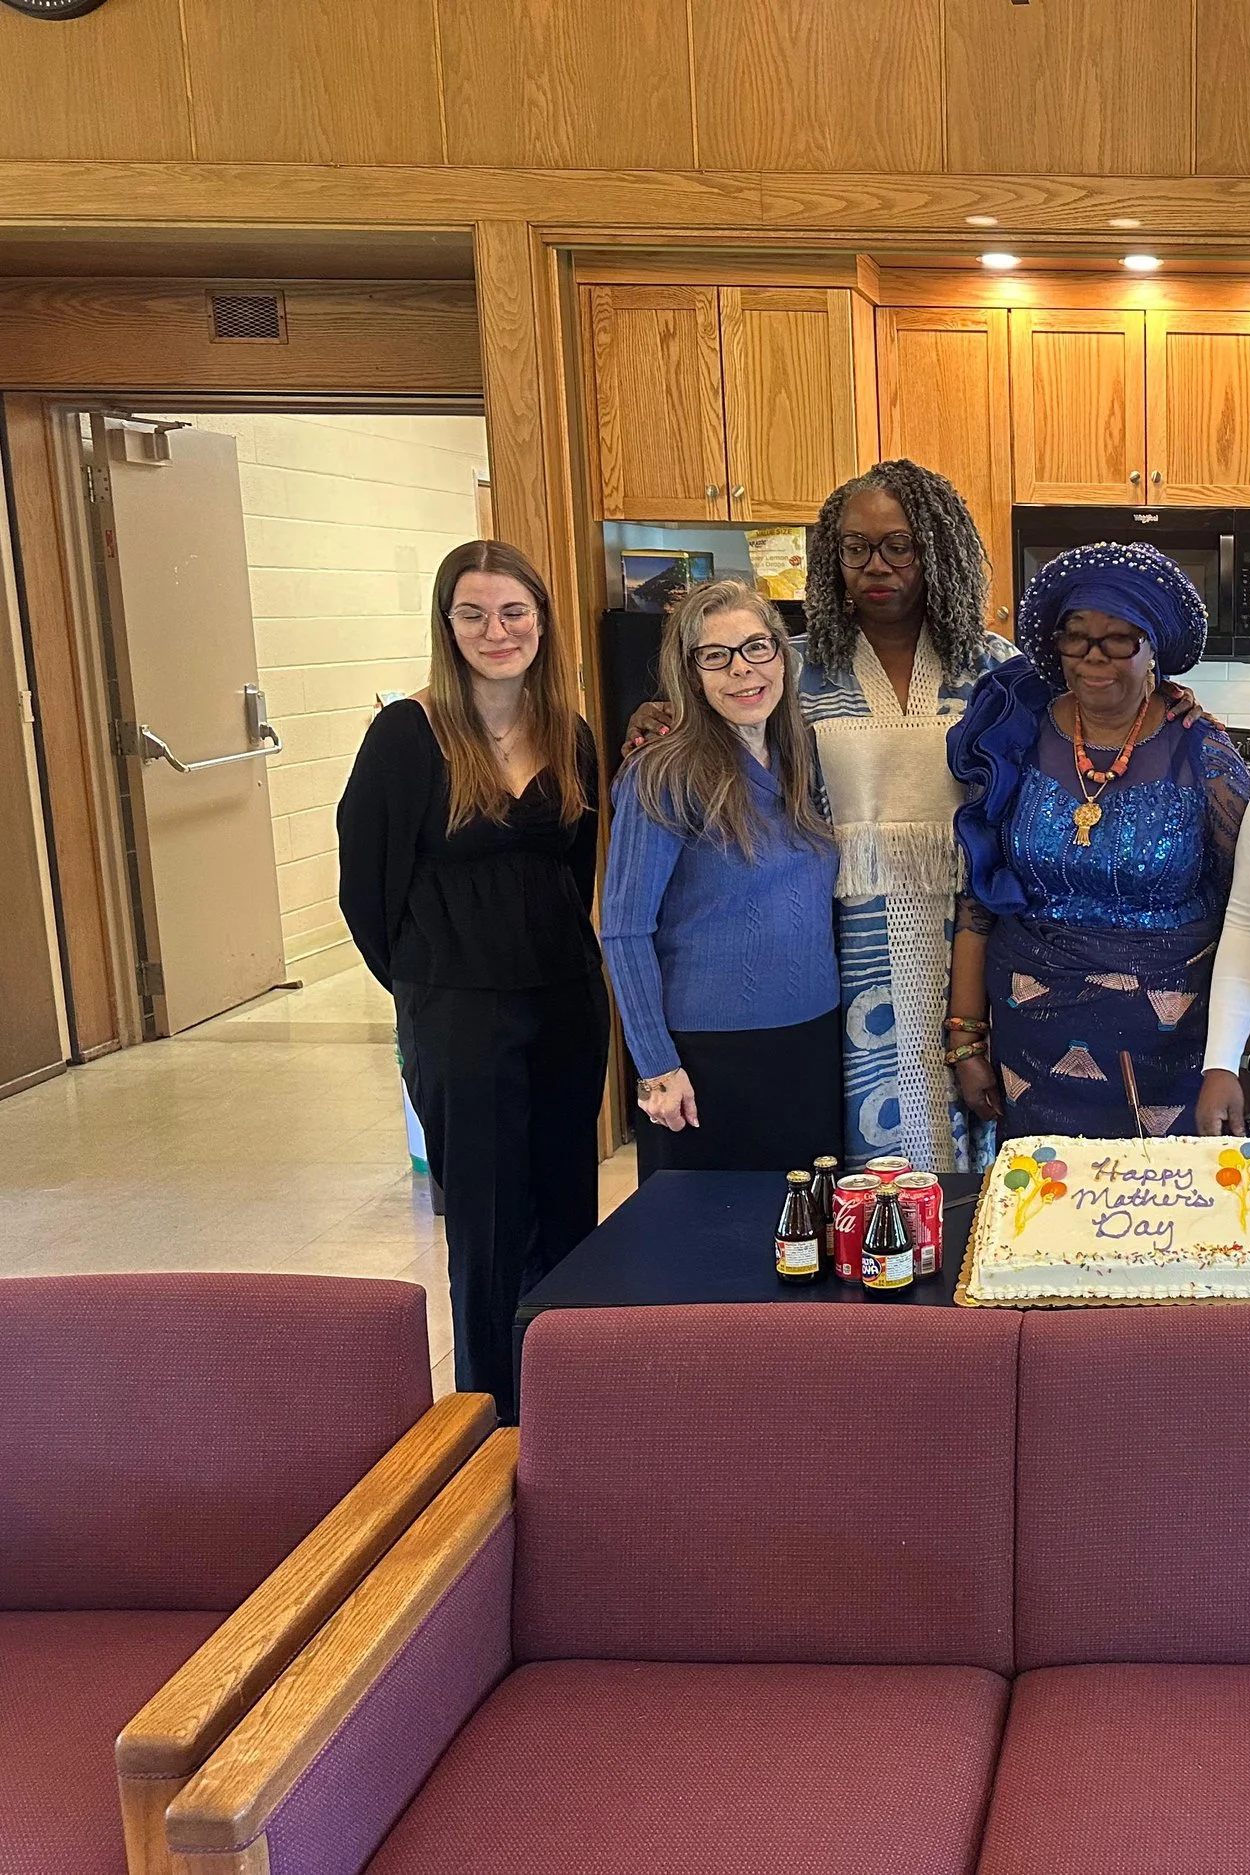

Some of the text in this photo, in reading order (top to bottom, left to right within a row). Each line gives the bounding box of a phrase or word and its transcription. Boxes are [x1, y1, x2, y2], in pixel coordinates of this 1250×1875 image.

[1091, 1156, 1193, 1190] Happy
[1071, 1187, 1215, 1209] Mother's
[1092, 1210, 1174, 1251] Day
[862, 1264, 879, 1275] OYA
